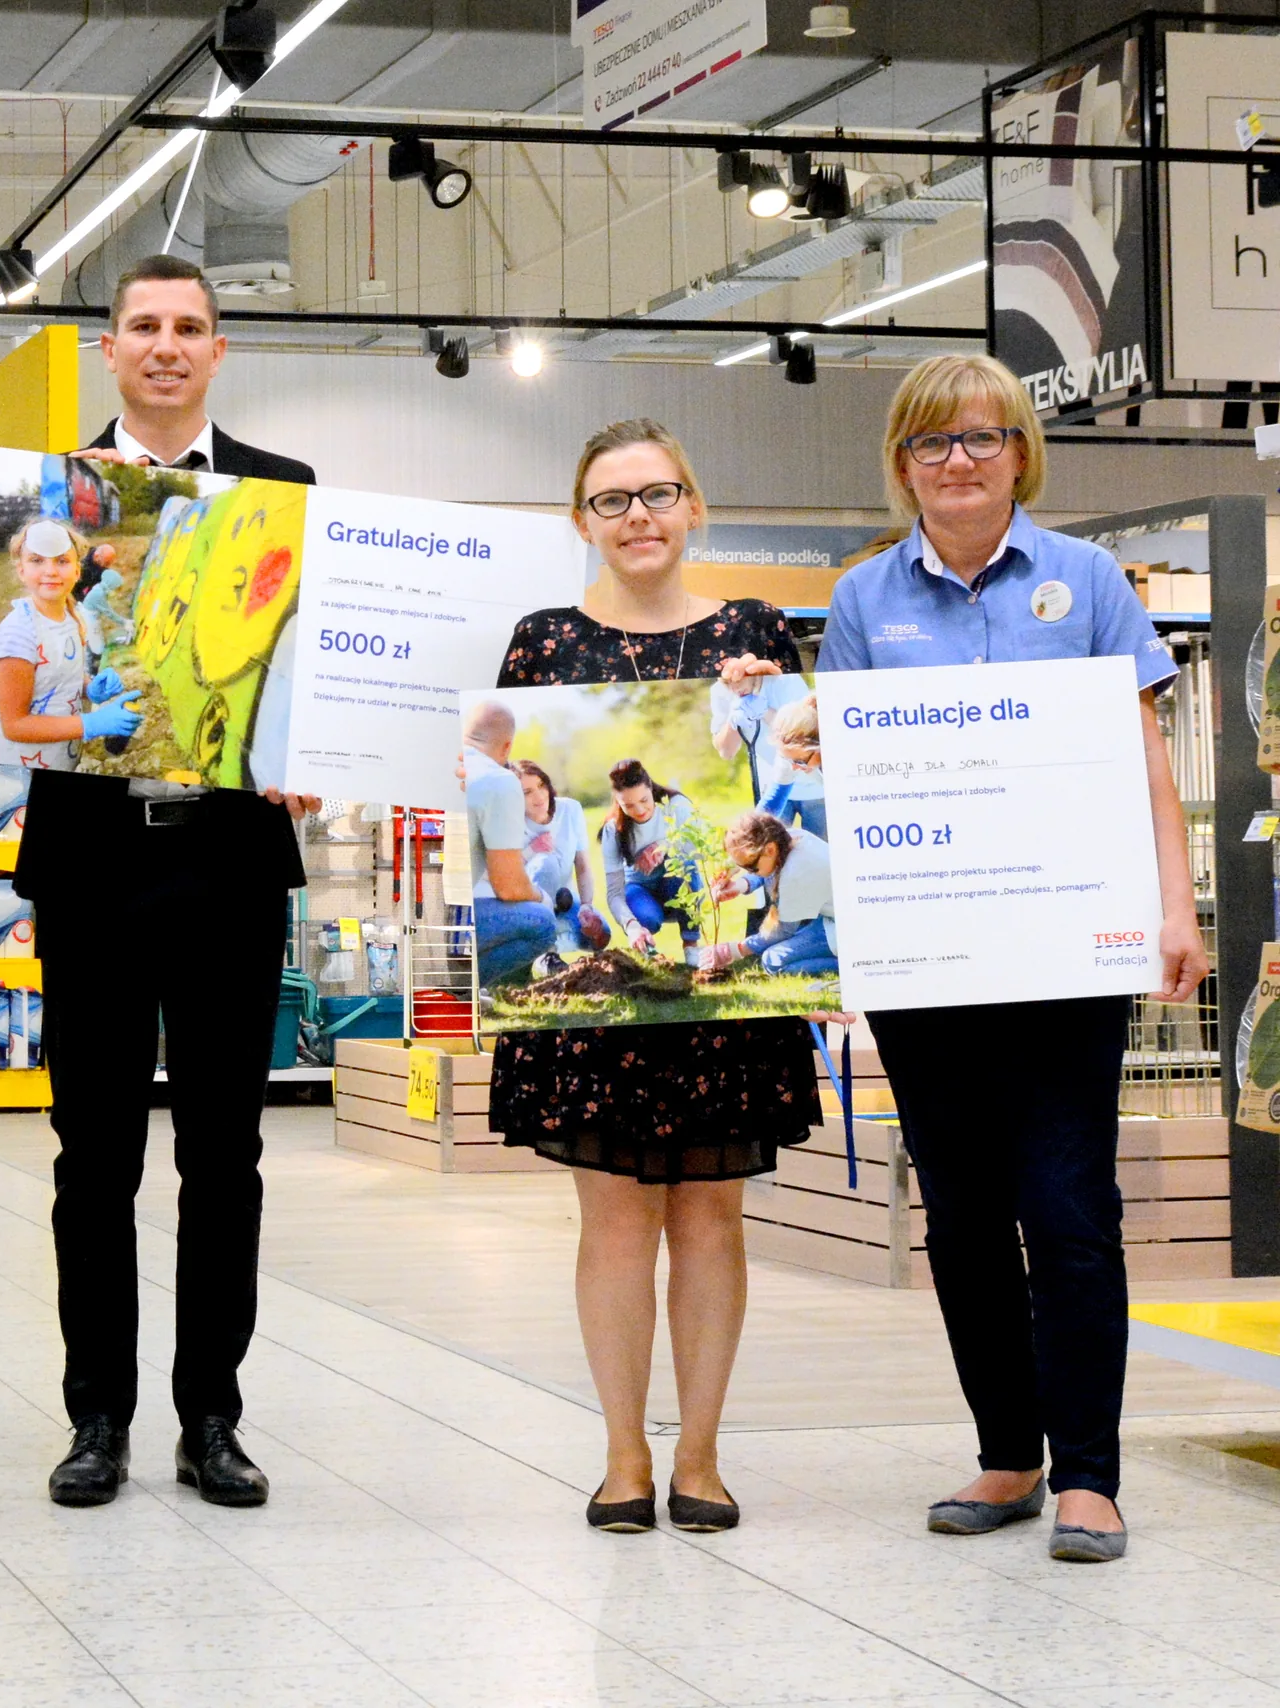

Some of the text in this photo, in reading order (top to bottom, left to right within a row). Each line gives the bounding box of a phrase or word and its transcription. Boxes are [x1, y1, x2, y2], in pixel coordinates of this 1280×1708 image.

[593, 19, 615, 39] TESCO
[594, 38, 641, 77] UBEZPIECZENIE
[605, 78, 637, 107] Zadzwoń
[648, 67, 661, 84] 444
[662, 57, 671, 76] 67
[672, 52, 682, 69] 40
[1001, 157, 1044, 188] home
[1020, 343, 1148, 412] TEKSTYLIA
[327, 521, 491, 559] Gratulacje dla
[778, 549, 831, 567] podłóg
[331, 600, 356, 611] zajęcie
[358, 603, 399, 616] pierwszego
[400, 608, 428, 619] miejsca
[434, 612, 467, 624] zdobycie
[881, 623, 919, 632] TESCO
[319, 629, 411, 659] 5000 zł
[326, 673, 361, 685] realizację
[363, 677, 398, 689] lokalnego
[399, 681, 431, 692] projektu
[314, 692, 355, 705] Dziękujemy
[367, 698, 390, 708] udział
[399, 702, 437, 714] programie
[843, 698, 1030, 729] Gratulacje dla
[857, 762, 915, 779] FUNDACJA
[924, 761, 946, 771] DLA
[860, 792, 889, 803] zajęcie
[891, 790, 930, 800] trzeciego
[931, 788, 963, 799] miejsca
[969, 785, 1006, 796] zdobycie
[853, 822, 952, 849] 1000 zł
[856, 865, 1045, 882] na realizację lokalnego projektu społecznego.
[858, 893, 905, 904] Dziękujemy
[918, 892, 943, 900] udział
[954, 888, 998, 899] programie
[1093, 931, 1144, 944] TESCO
[1095, 954, 1148, 967] Fundacja
